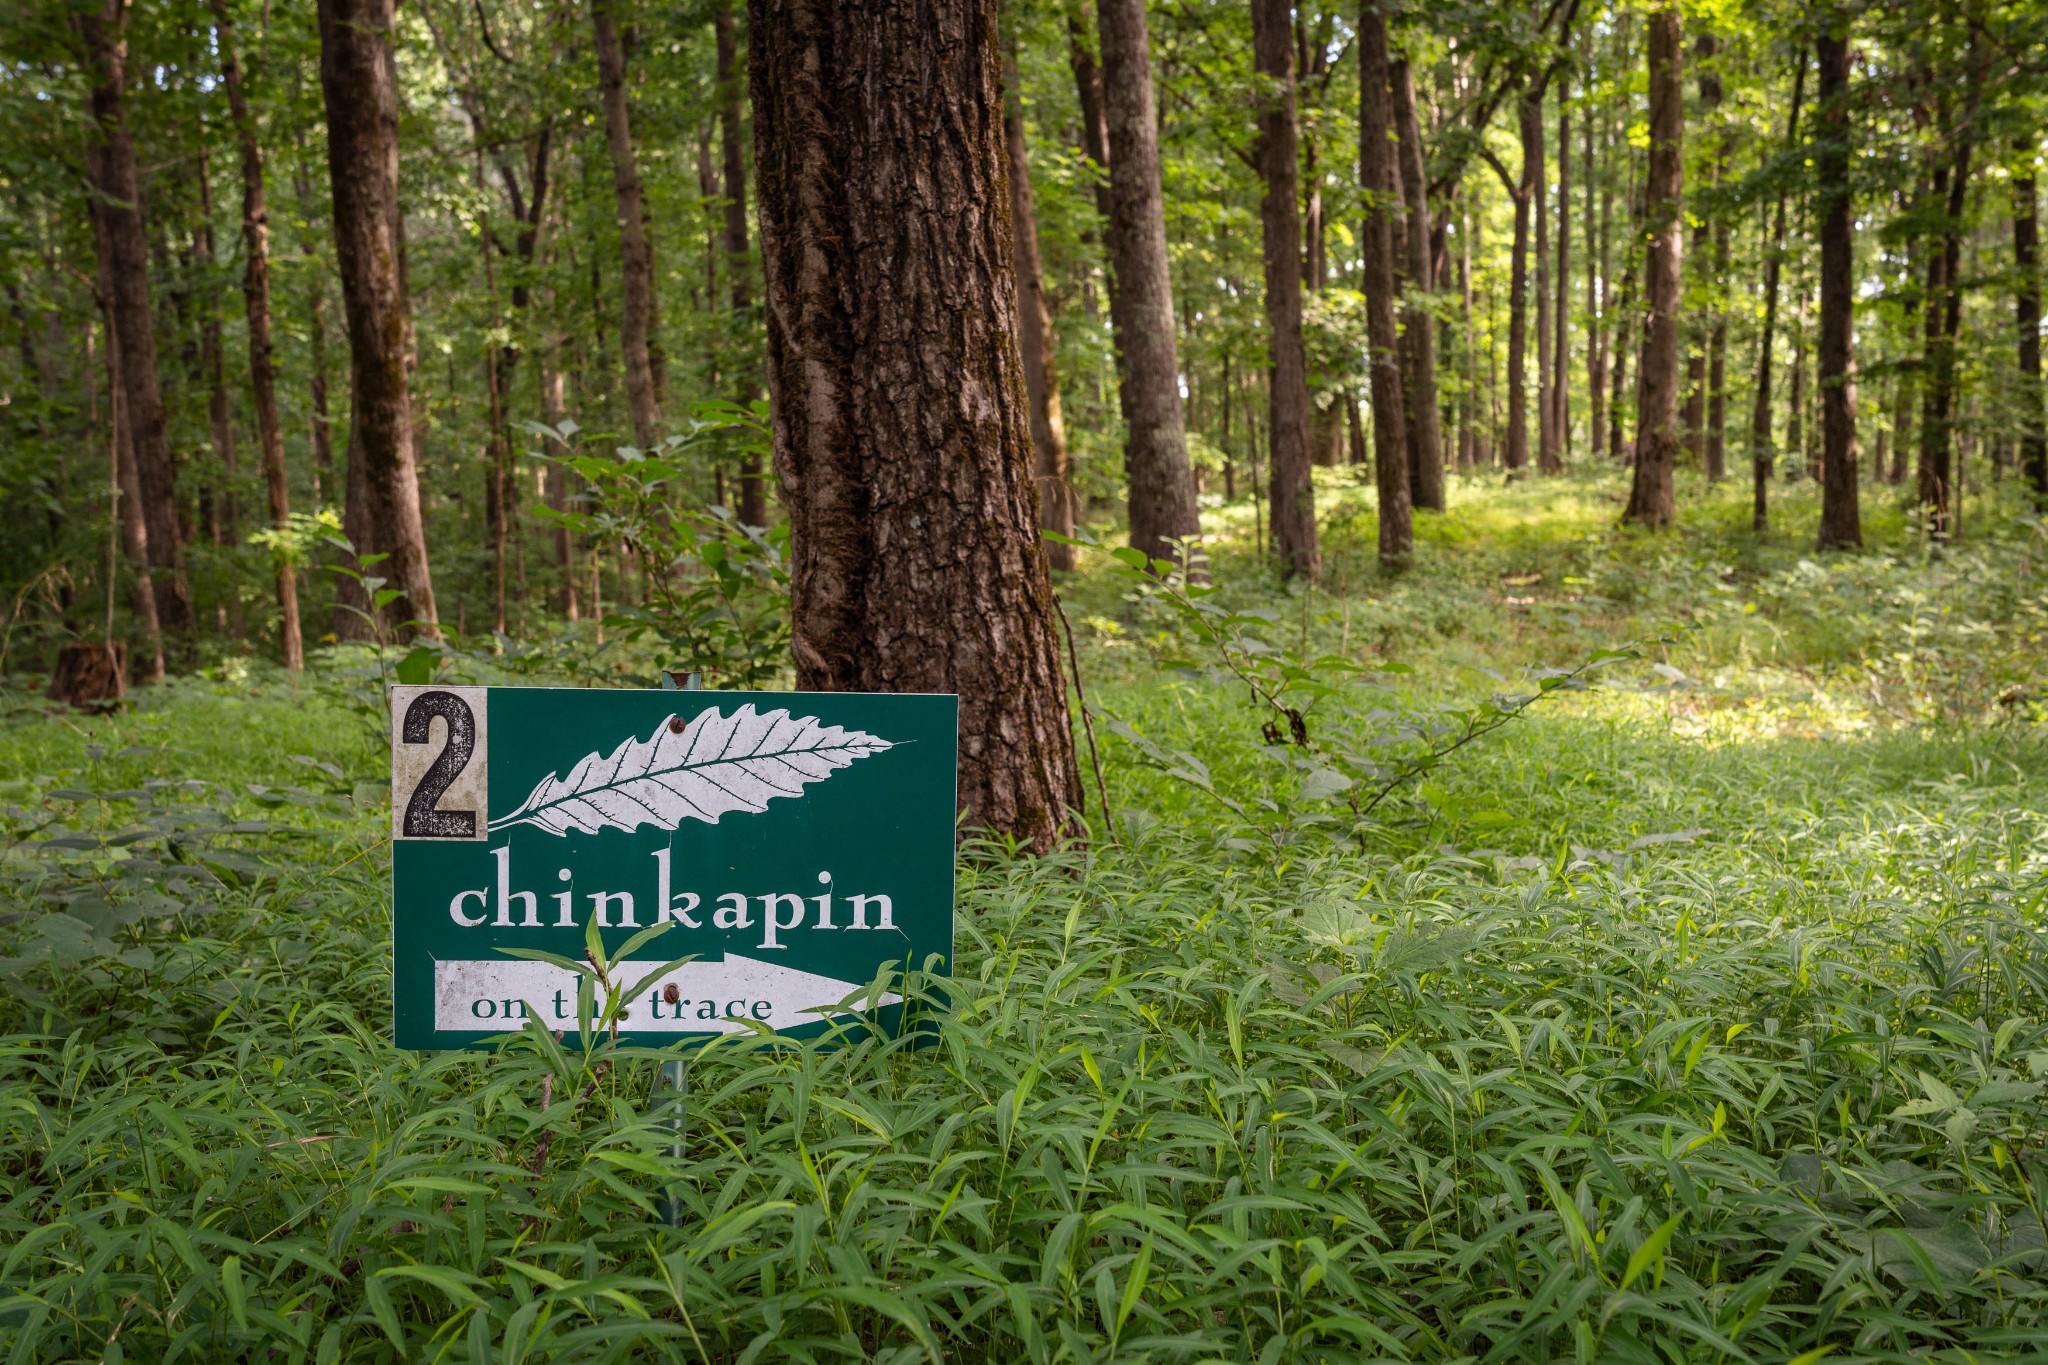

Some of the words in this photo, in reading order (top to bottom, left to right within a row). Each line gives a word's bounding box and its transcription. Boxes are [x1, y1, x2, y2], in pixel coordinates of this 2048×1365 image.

[402, 690, 476, 838] 2
[449, 846, 898, 949] chinkapin
[471, 998, 530, 1019] on
[552, 974, 621, 1019] th
[649, 989, 773, 1020] trace
